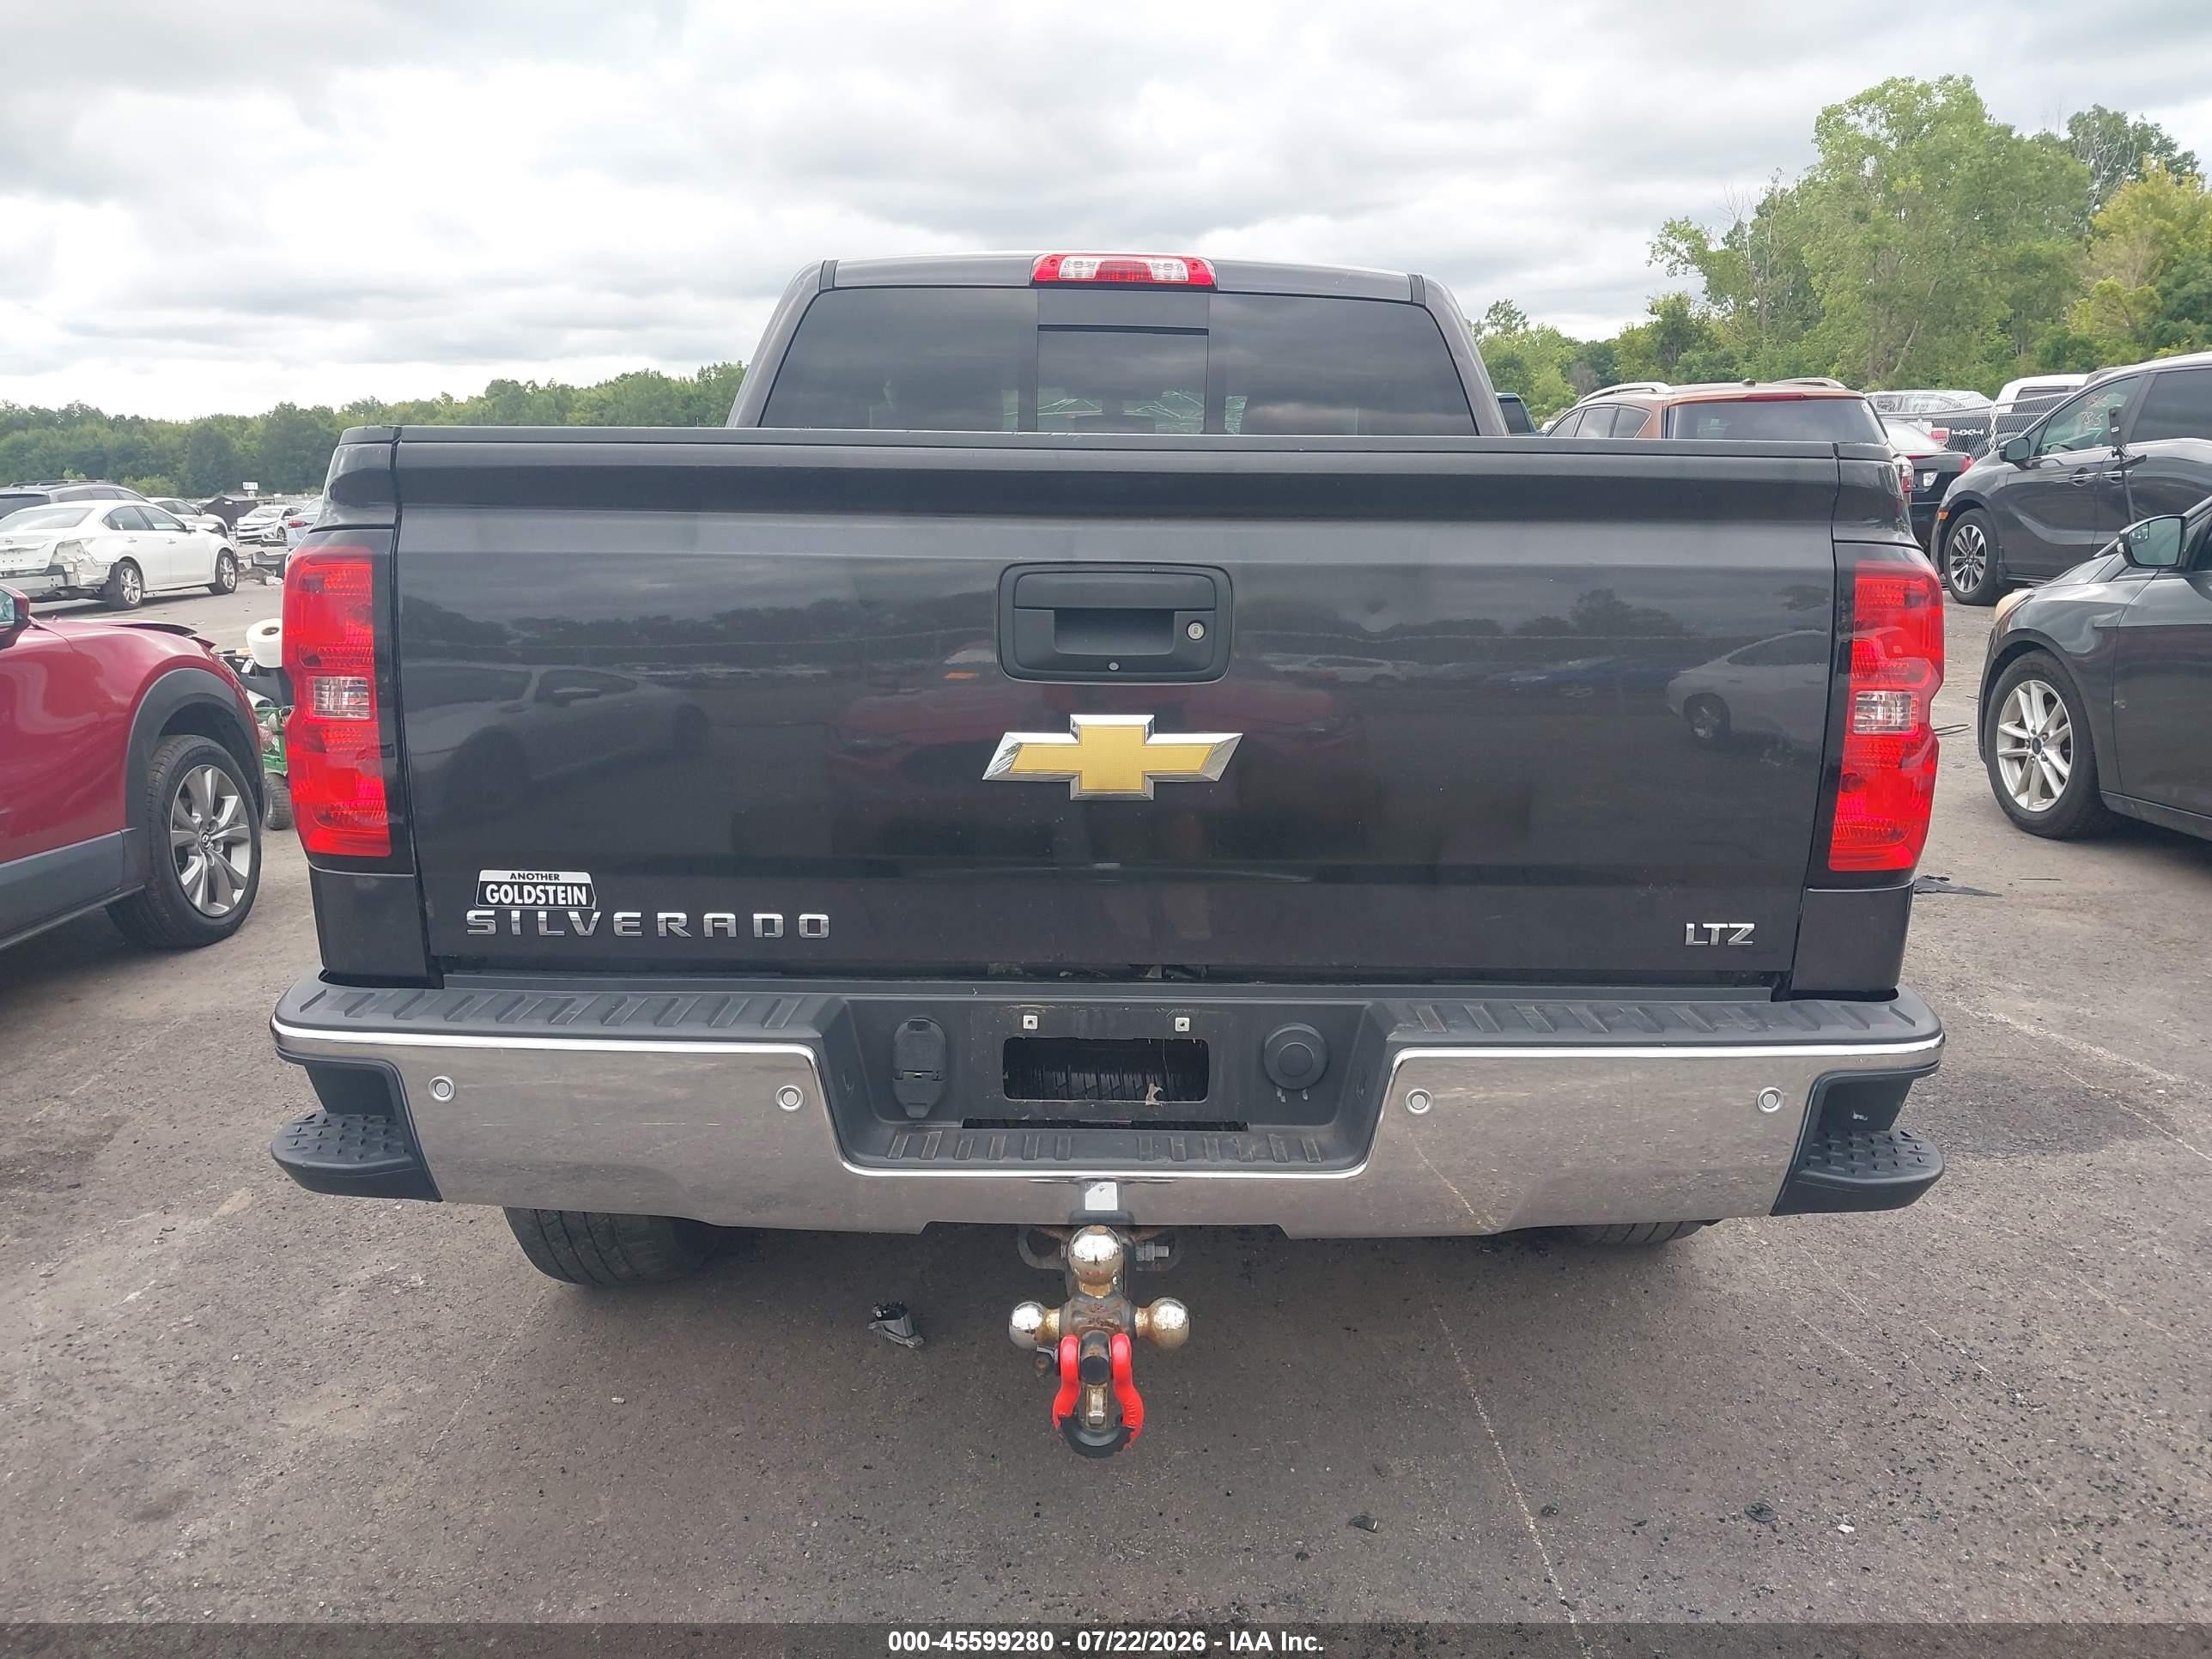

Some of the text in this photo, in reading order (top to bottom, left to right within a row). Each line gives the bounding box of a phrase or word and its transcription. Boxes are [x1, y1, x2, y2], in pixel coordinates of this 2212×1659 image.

[509, 872, 561, 881] ANOTHER
[485, 884, 587, 905] GOLDSTEIN
[465, 909, 830, 939] SILVERADO
[1685, 922, 1755, 945] LTZ
